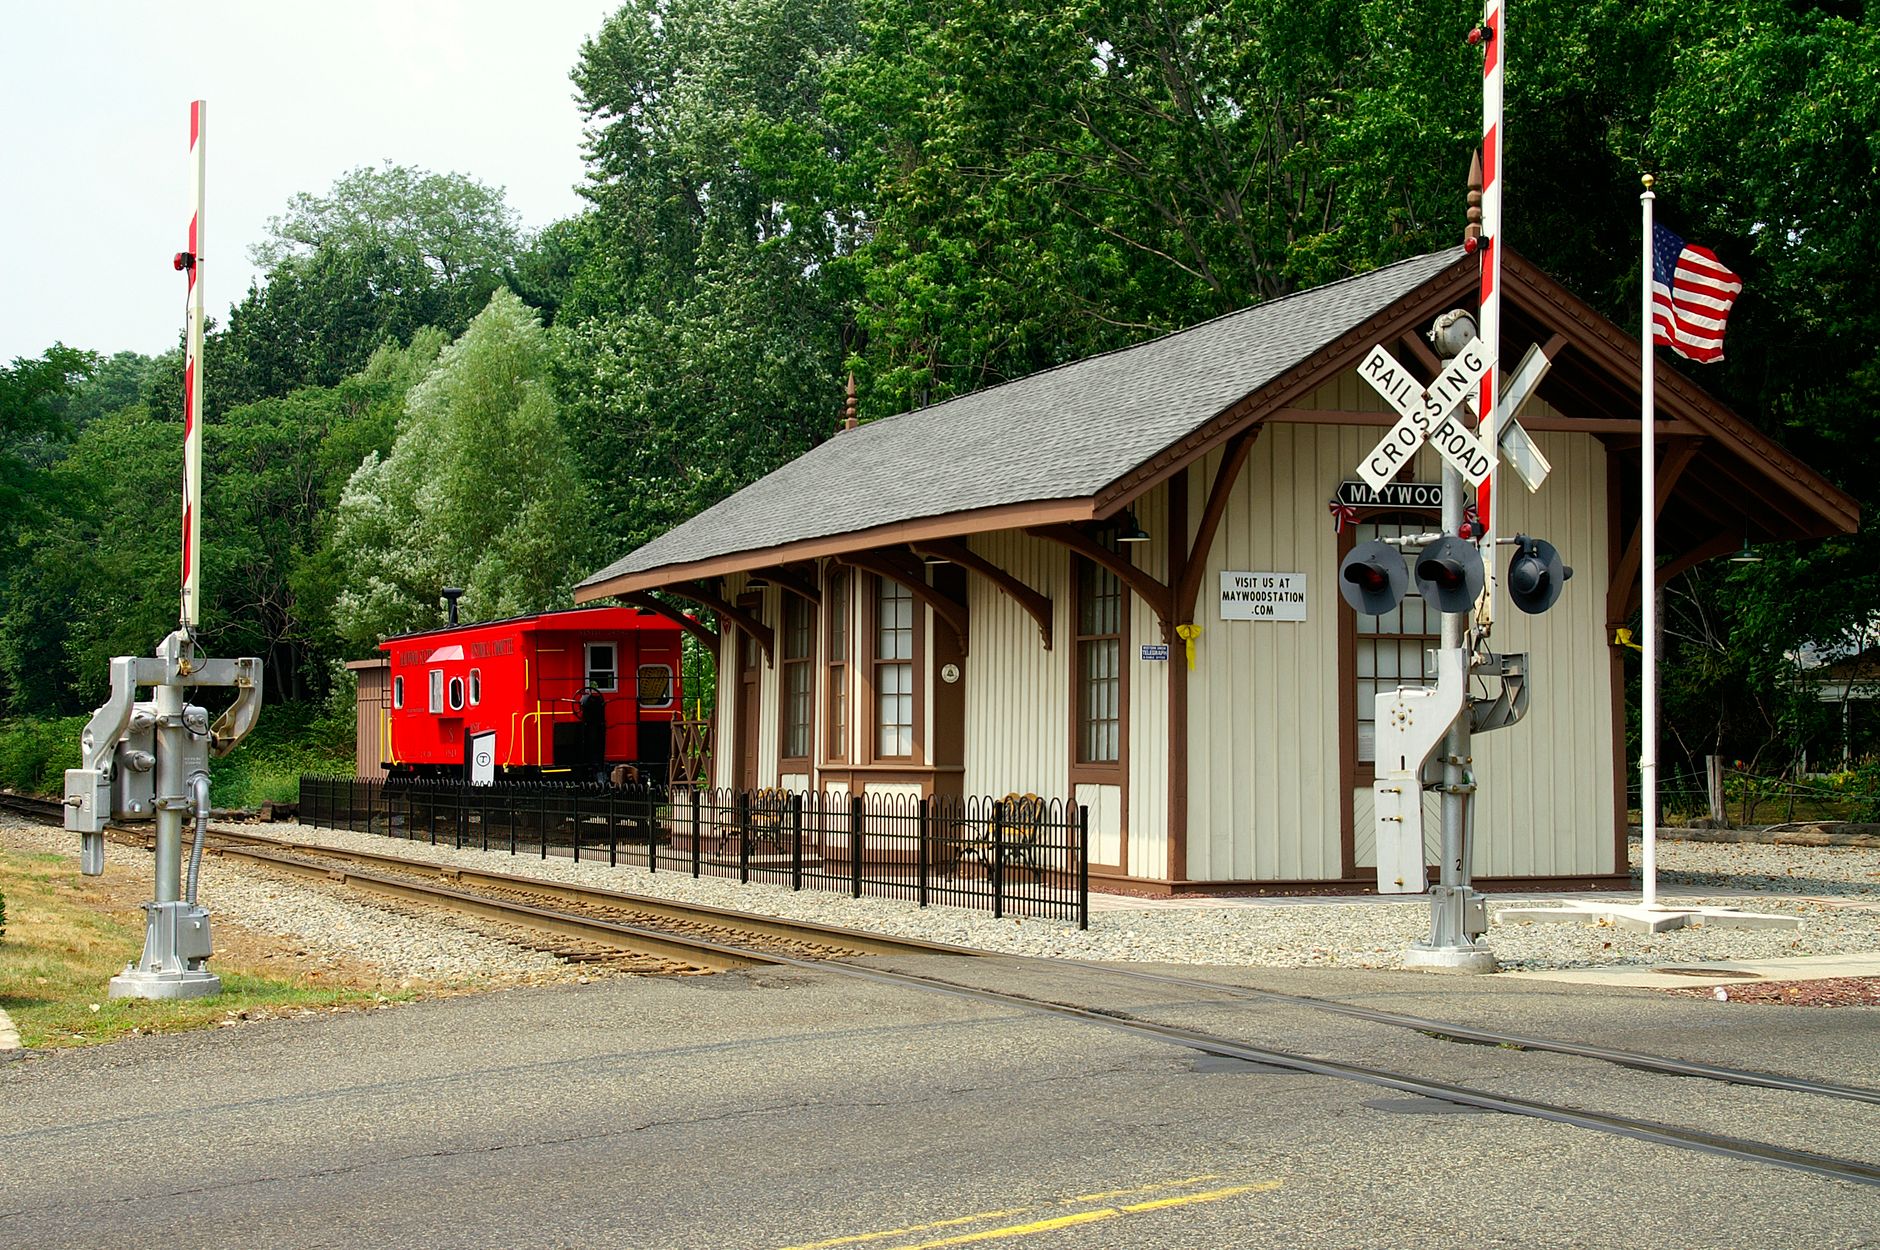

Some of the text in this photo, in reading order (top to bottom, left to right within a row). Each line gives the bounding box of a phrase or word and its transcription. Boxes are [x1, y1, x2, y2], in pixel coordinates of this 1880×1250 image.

[1365, 353, 1489, 477] RAIL ROAD
[1370, 352, 1482, 477] CROSSING
[1350, 485, 1442, 504] MAYWOO
[1235, 577, 1290, 588] VISIT US AT
[1222, 591, 1304, 602] MAYWOODSTATION
[1251, 605, 1273, 615] .COM
[1456, 858, 1461, 871] 2
